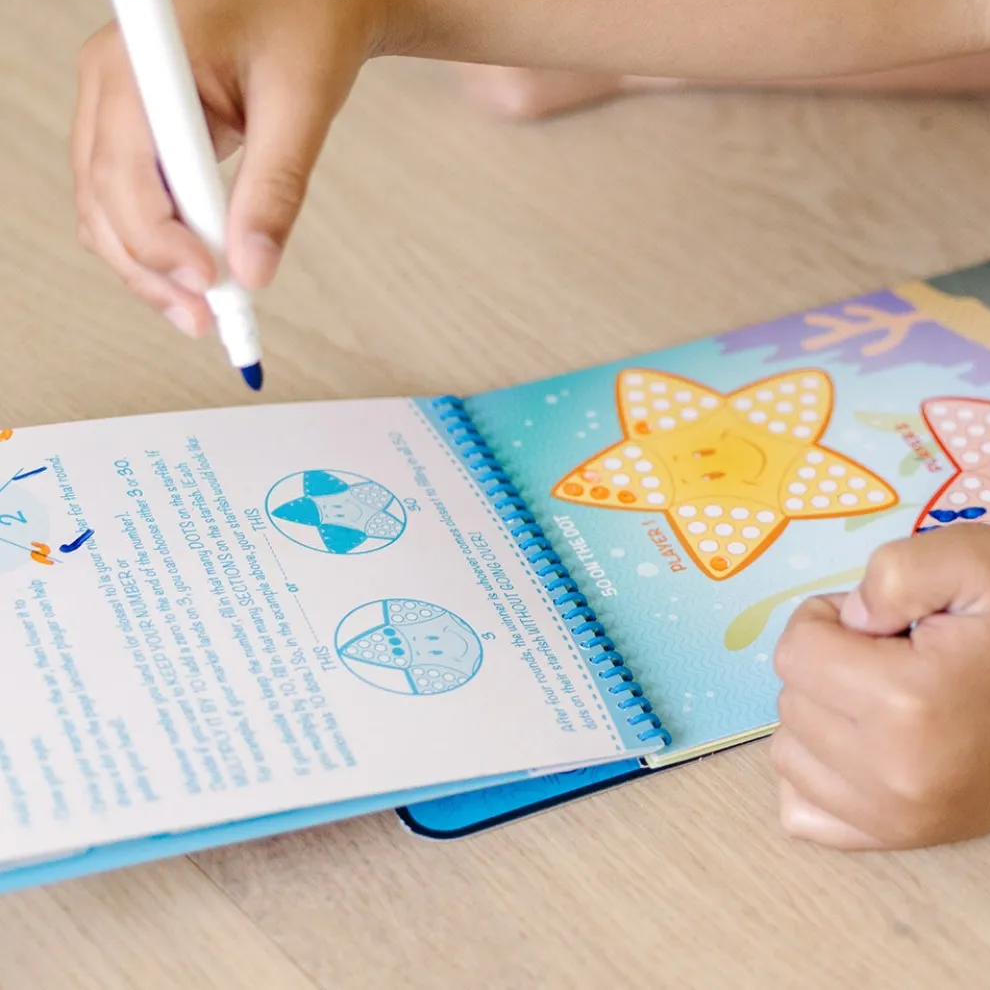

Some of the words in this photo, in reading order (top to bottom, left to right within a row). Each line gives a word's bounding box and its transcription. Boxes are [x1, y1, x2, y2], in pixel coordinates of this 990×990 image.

[45, 454, 68, 482] round.
[114, 458, 134, 476] 30.
[192, 452, 210, 470] look
[152, 458, 177, 492] starfish.
[174, 462, 198, 488] (Each
[199, 471, 223, 495] would
[59, 484, 76, 500] that
[169, 493, 184, 506] the
[67, 503, 82, 516] for
[136, 498, 155, 522] either
[178, 508, 191, 519] on
[188, 488, 215, 523] starfish.
[213, 496, 240, 528] starfish
[403, 498, 421, 512] 30
[430, 498, 456, 527] closest
[0, 510, 27, 526] 2
[244, 508, 266, 532] THIS
[554, 516, 580, 538] DOT
[76, 519, 97, 549] nuber
[115, 512, 144, 550] number).
[148, 524, 170, 555] choose
[179, 521, 204, 550] DOTS
[207, 525, 221, 538] the
[233, 530, 256, 550] your
[450, 528, 472, 554] comes
[216, 540, 229, 552] on
[468, 532, 496, 561] OVER!
[569, 536, 594, 562] THE
[644, 526, 687, 572] PLAYER
[90, 553, 112, 572] your
[135, 551, 150, 566] the
[163, 556, 178, 574] can
[198, 550, 216, 575] many
[246, 552, 265, 580] above,
[217, 553, 254, 606] SECTIONS
[466, 556, 494, 591] whoever
[486, 562, 514, 590] GOING
[584, 562, 605, 578] ON
[28, 580, 47, 599] help
[98, 584, 117, 596] to)
[118, 570, 148, 618] NUMBER
[144, 579, 164, 596] end
[172, 575, 192, 592] you
[208, 577, 225, 595] that
[596, 578, 618, 596] 50
[14, 599, 26, 610] to
[39, 600, 56, 618] can
[156, 597, 171, 612] the
[176, 593, 193, 606] 3,
[256, 582, 285, 620] example
[108, 600, 133, 633] closest
[186, 608, 200, 619] on
[218, 606, 237, 618] fill
[248, 606, 268, 634] many
[493, 602, 517, 632] winner
[504, 593, 540, 635] WITHOUT
[47, 620, 72, 650] player
[138, 620, 164, 652] YOUR
[170, 625, 188, 645] zero
[189, 621, 212, 648] lands
[231, 619, 255, 658] number,
[276, 622, 292, 636] the
[124, 635, 140, 648] (or
[258, 635, 276, 654] that
[511, 633, 526, 647] the
[132, 650, 146, 662] on
[290, 647, 307, 665] So,
[312, 646, 336, 672] THIS
[532, 636, 562, 670] starfish
[134, 664, 155, 686] land
[153, 654, 179, 686] KEEP
[179, 656, 201, 678] (add
[248, 659, 262, 674] the
[270, 666, 288, 678] fill
[520, 648, 547, 684] rounds,
[172, 686, 185, 697] to
[189, 679, 208, 694] 10
[279, 678, 298, 697] 10,
[556, 673, 576, 694] their
[541, 685, 560, 706] four
[570, 695, 585, 708] on
[554, 707, 576, 732] After
[579, 709, 598, 730] dots
